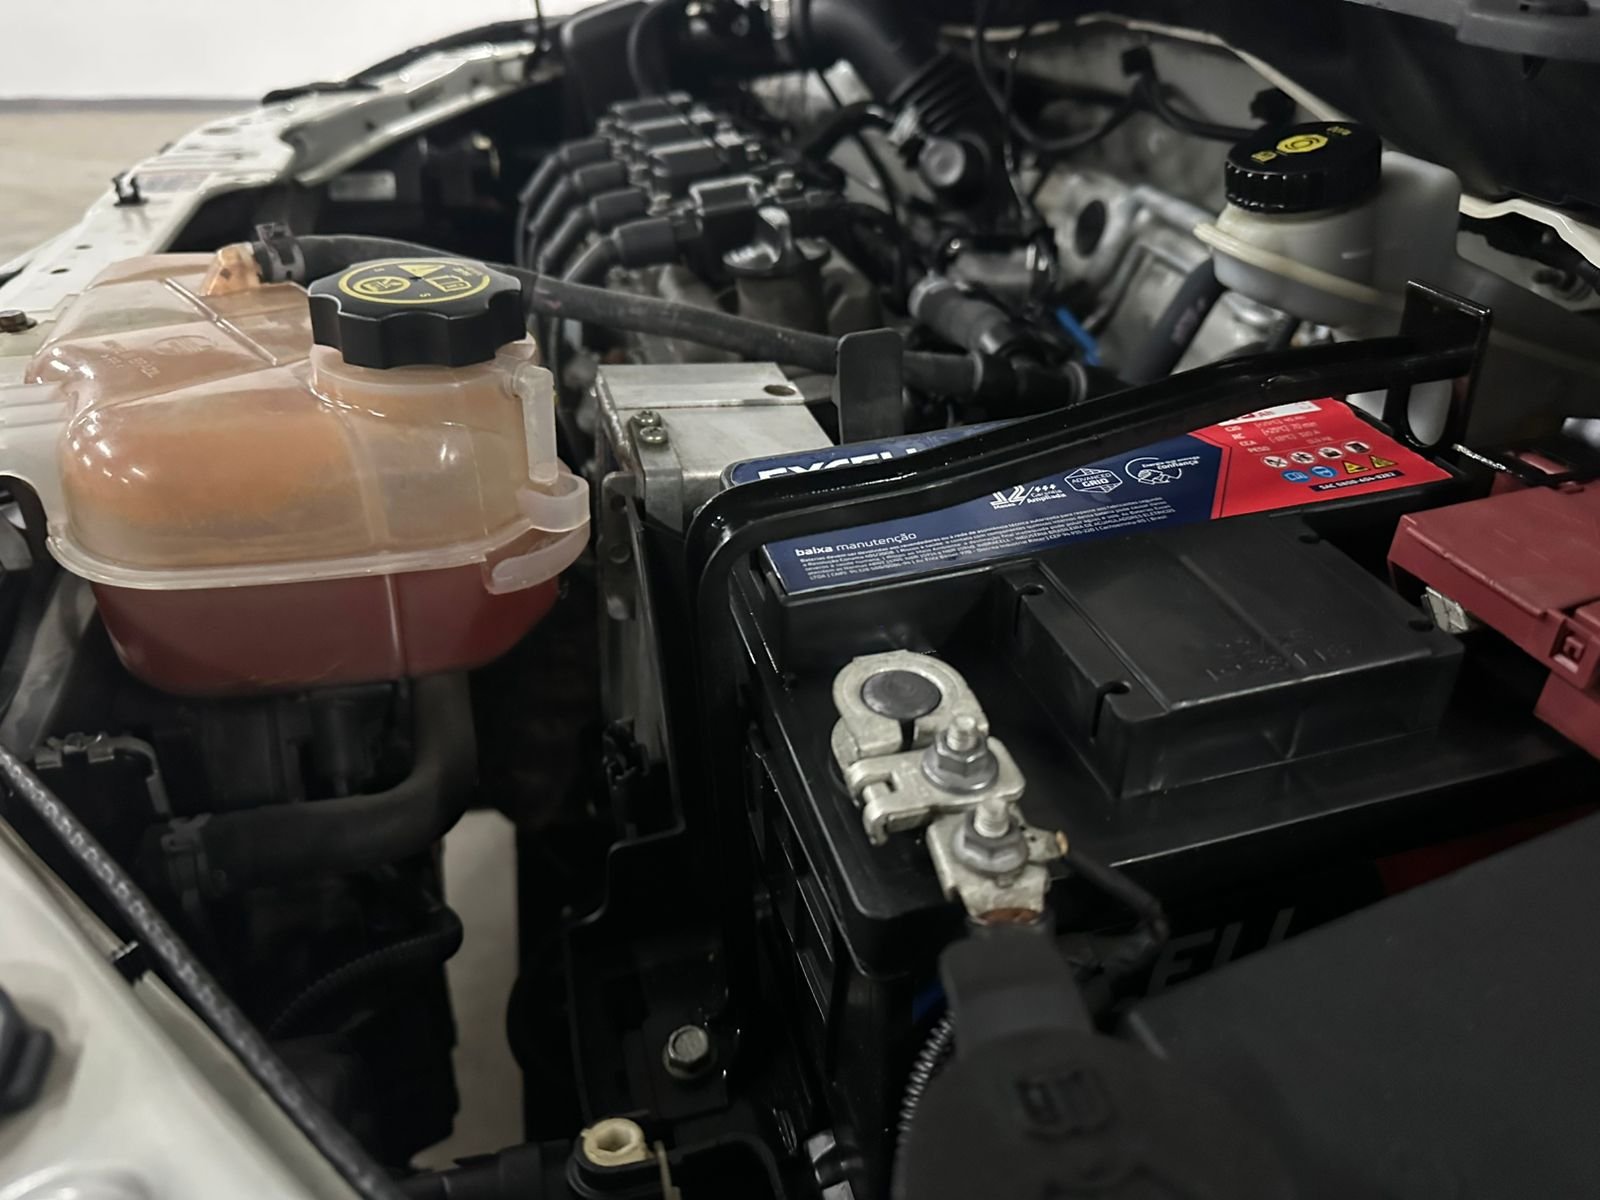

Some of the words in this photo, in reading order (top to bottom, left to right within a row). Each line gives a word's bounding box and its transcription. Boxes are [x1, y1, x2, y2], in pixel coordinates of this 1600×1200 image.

[1072, 473, 1111, 483] ADVANCED
[1081, 478, 1109, 487] GRID
[1027, 493, 1067, 503] Ampliada
[795, 545, 833, 557] baixa
[836, 533, 917, 553] manutenção
